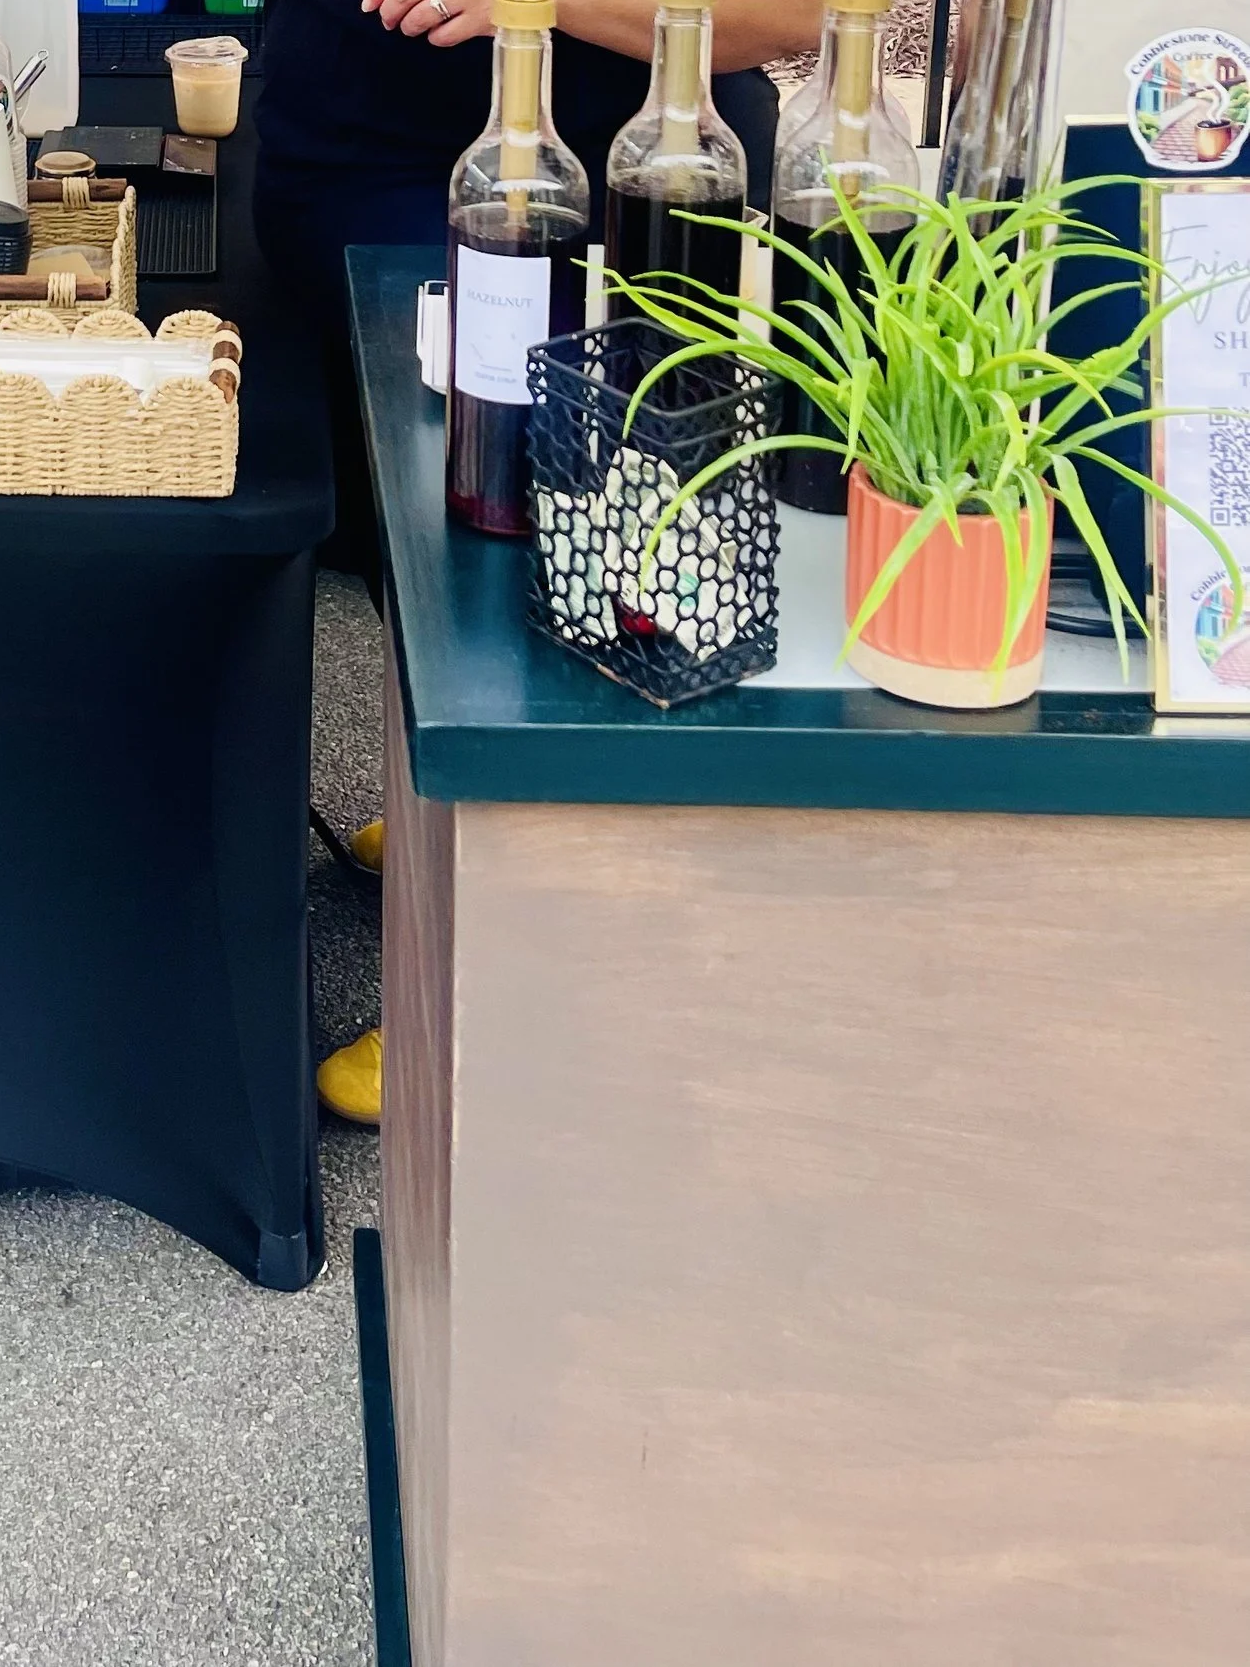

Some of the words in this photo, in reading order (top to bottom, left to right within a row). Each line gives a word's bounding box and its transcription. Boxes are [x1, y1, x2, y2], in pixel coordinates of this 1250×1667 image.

[1131, 33, 1211, 75] Cobblestone
[1172, 51, 1214, 63] Coffee
[466, 288, 534, 308] HAZELNUT
